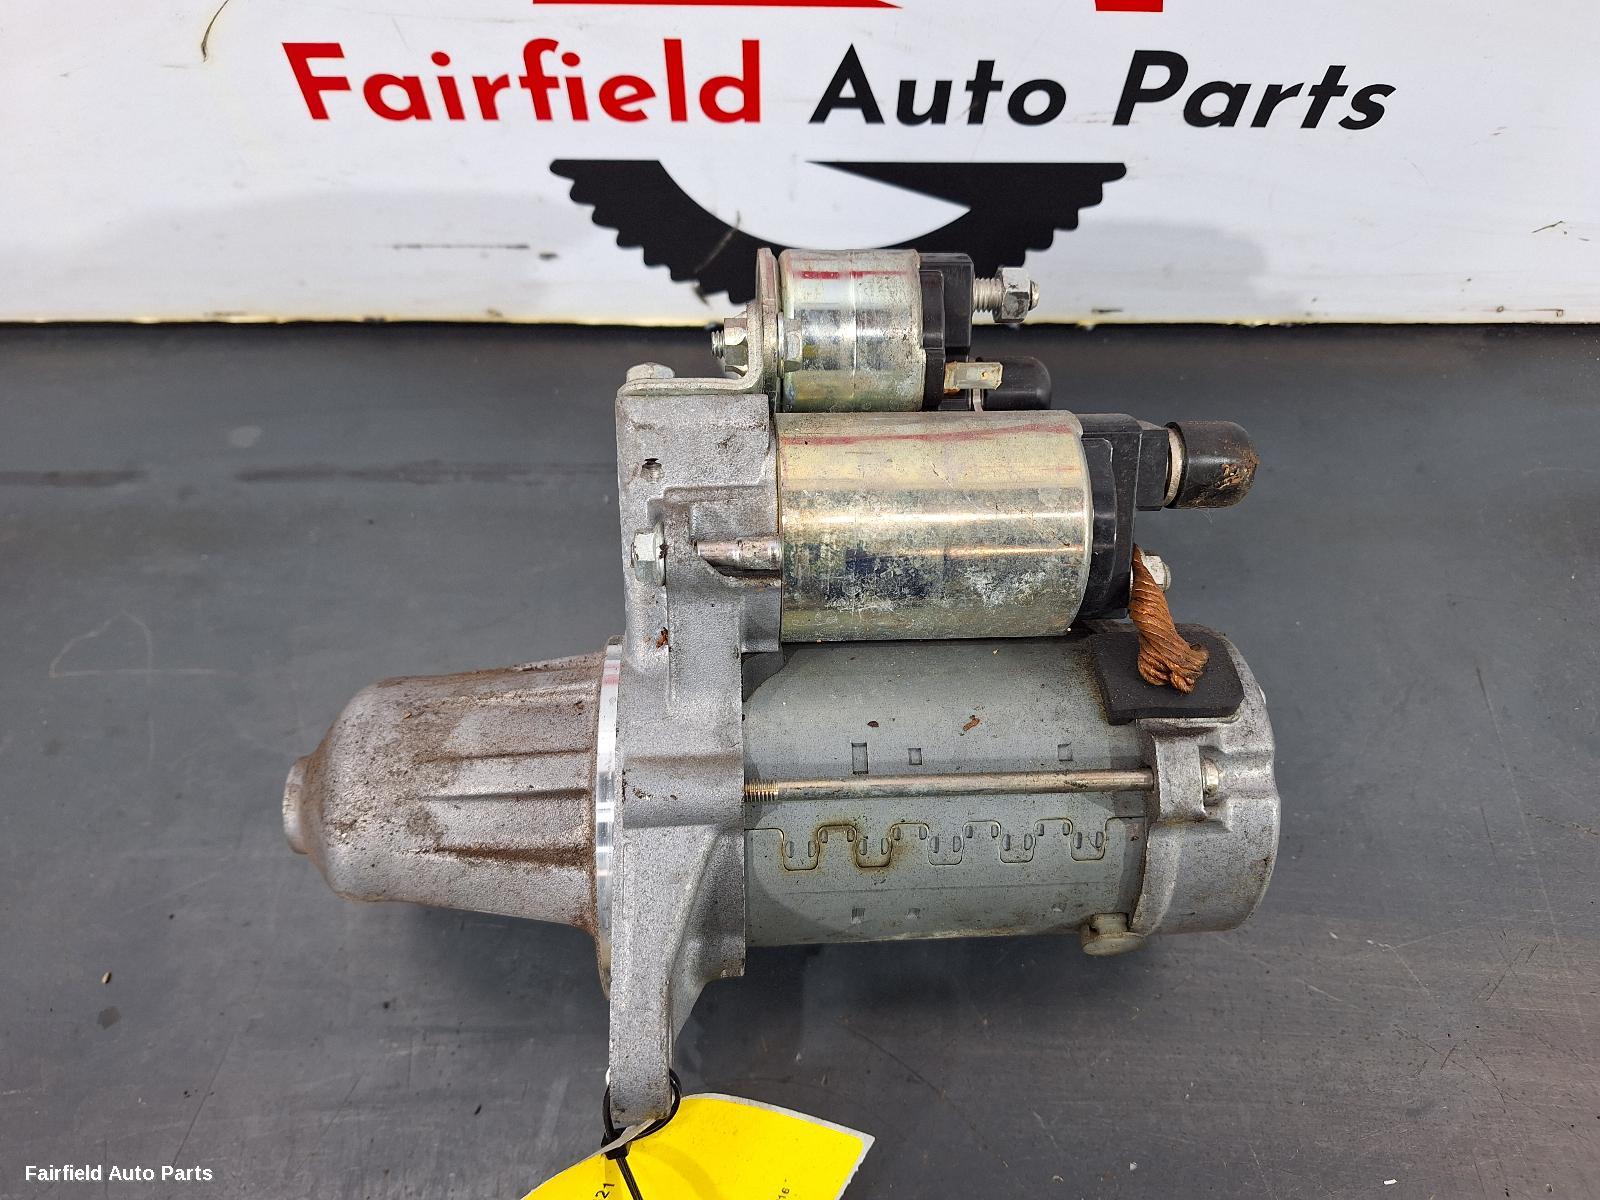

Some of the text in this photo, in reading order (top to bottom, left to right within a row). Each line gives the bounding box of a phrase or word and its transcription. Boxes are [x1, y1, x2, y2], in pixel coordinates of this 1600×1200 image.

[281, 38, 1397, 131] Fairfield Auto Parts
